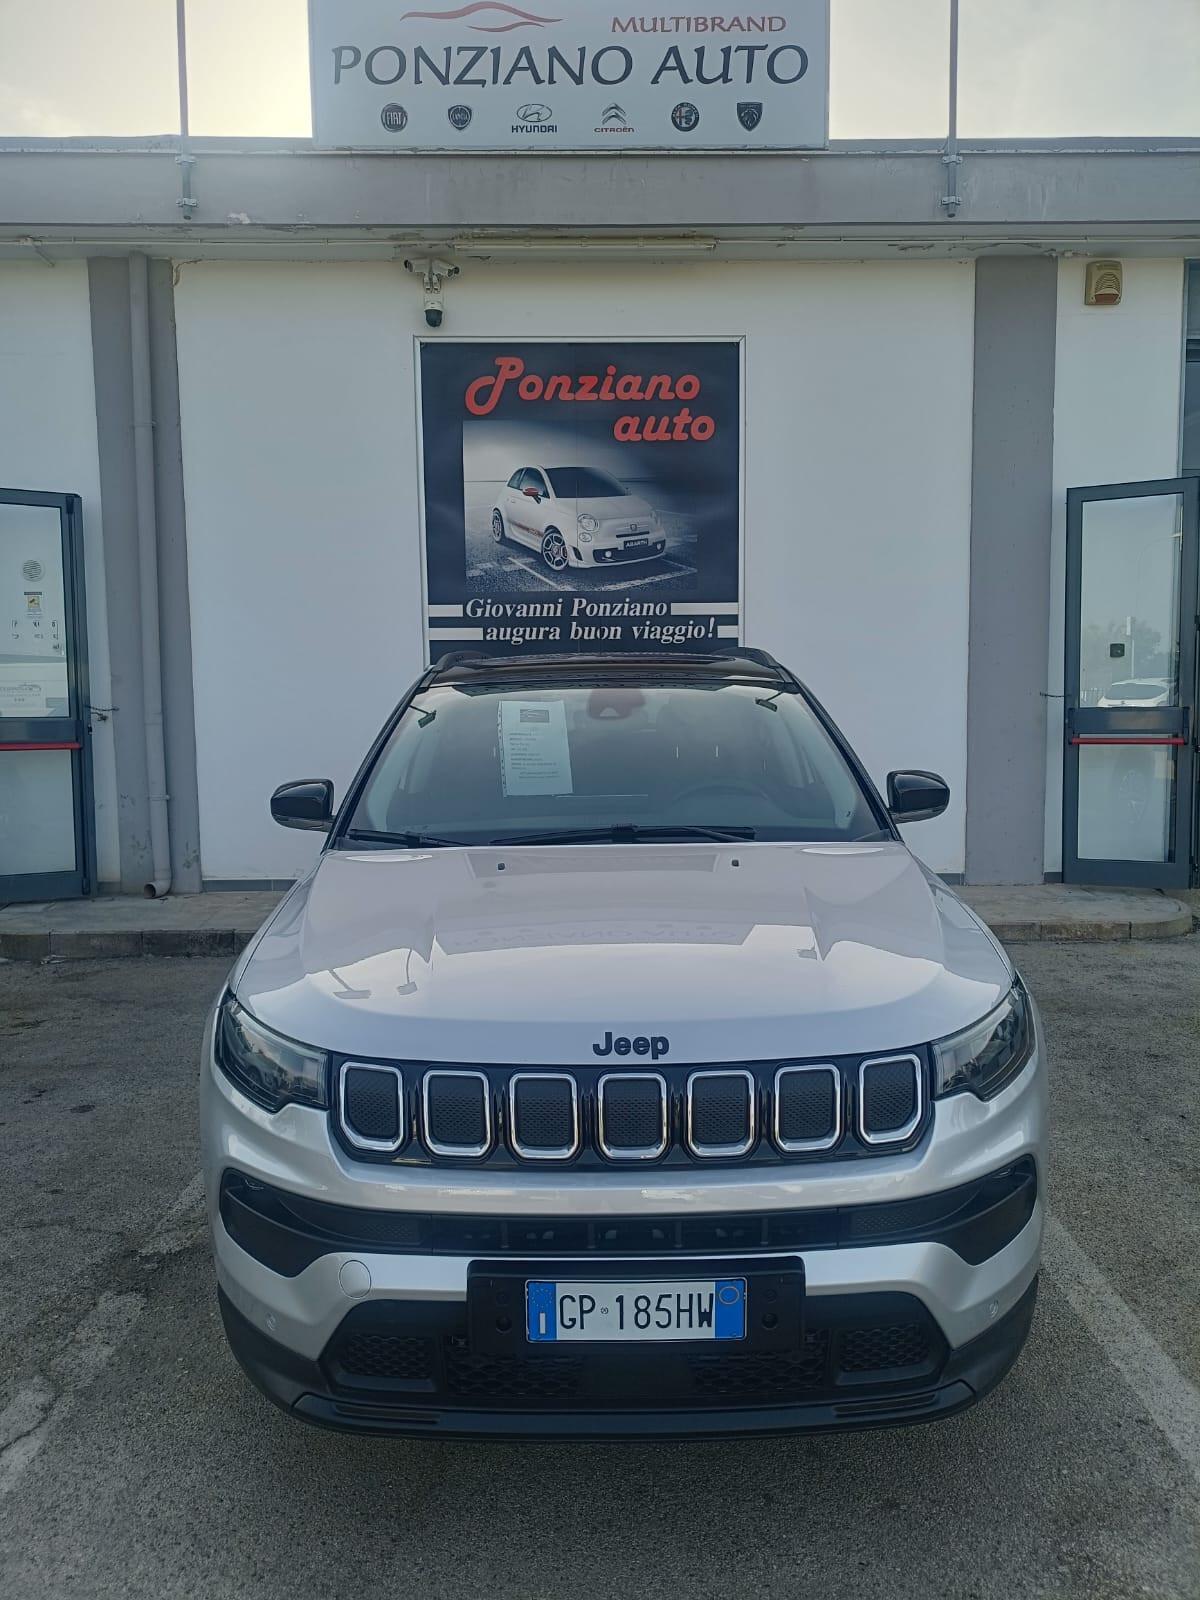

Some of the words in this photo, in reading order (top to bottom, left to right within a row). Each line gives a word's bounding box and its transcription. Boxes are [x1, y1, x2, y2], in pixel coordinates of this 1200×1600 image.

[611, 15, 787, 33] MULTIBRAND
[332, 45, 634, 88] PONZIANO
[650, 43, 809, 86] AUTO
[386, 111, 403, 126] FIAT
[511, 124, 558, 133] HYUNDAI
[465, 356, 700, 416] Ponziano
[613, 407, 716, 442] auto
[465, 597, 563, 618] Giovanni
[570, 597, 668, 617] Ponziano
[486, 625, 561, 646] augura
[570, 621, 622, 640] buon
[632, 616, 715, 644] viaggio!
[592, 1031, 670, 1060] Jeep
[559, 1294, 596, 1330] GP
[615, 1292, 714, 1330] 185HW
